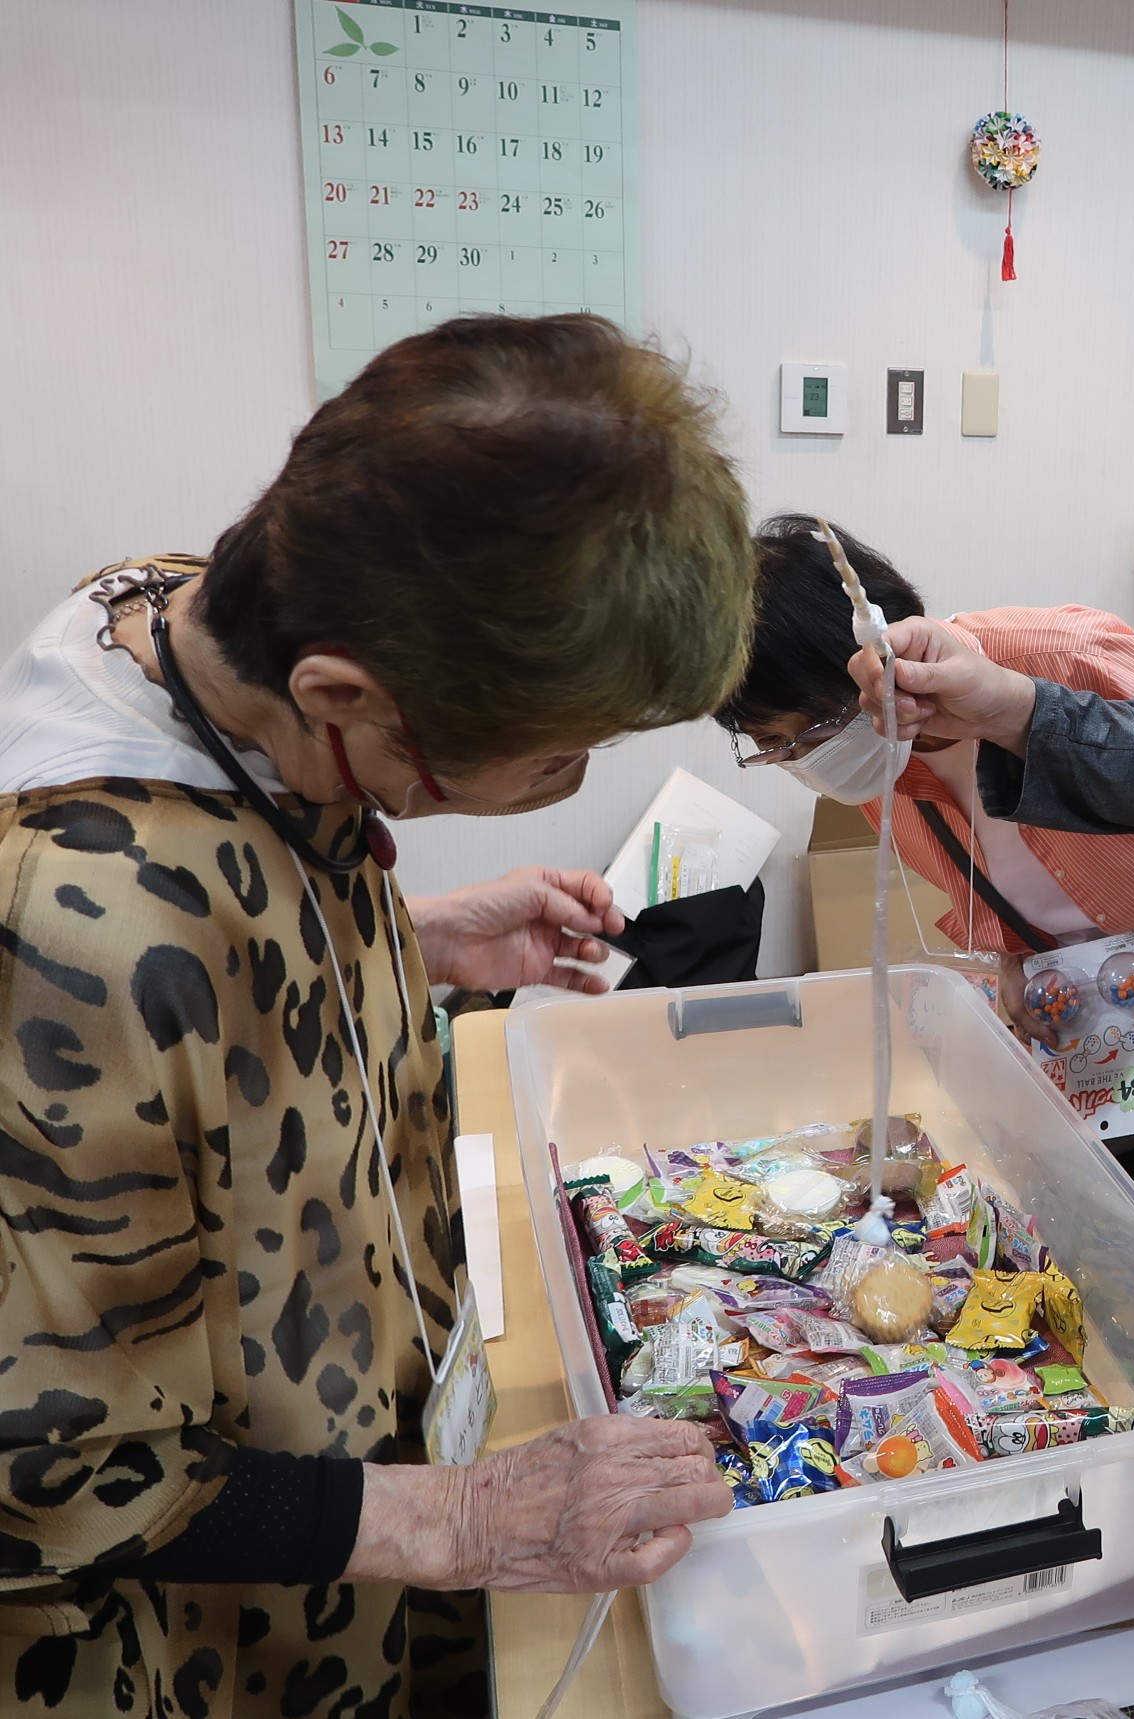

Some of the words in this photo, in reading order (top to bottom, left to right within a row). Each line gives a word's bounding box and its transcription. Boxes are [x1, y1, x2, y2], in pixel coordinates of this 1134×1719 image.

[416, 1, 424, 9] 火
[460, 6, 468, 14] 水
[504, 10, 512, 18] 木
[549, 15, 556, 23] 金
[590, 19, 598, 27] 土
[414, 14, 422, 34] 1
[457, 18, 470, 39] 2
[500, 23, 511, 43] 3
[543, 28, 554, 47] 4
[586, 32, 596, 51] 5
[323, 65, 336, 85] 6
[370, 69, 380, 89] 7
[414, 72, 426, 93] 8
[458, 76, 470, 96] 9
[498, 81, 518, 101] 10
[541, 85, 559, 105] 11
[583, 88, 602, 108] 12
[323, 124, 344, 145] 13
[367, 127, 389, 148] 14
[412, 131, 434, 151] 15
[456, 134, 477, 155] 16
[500, 138, 520, 157] 17
[542, 141, 562, 161] 18
[584, 144, 604, 164] 19
[324, 182, 347, 203] 20
[369, 185, 392, 205] 21
[414, 188, 435, 208] 22
[458, 191, 479, 211] 23
[500, 193, 521, 214] 24
[542, 196, 564, 217] 25
[584, 199, 605, 219] 26
[328, 239, 350, 260] 27
[372, 242, 395, 262] 28
[416, 244, 438, 264] 29
[459, 247, 481, 267] 30
[510, 250, 515, 261] 1
[551, 252, 558, 263] 2
[592, 254, 599, 265] 3
[338, 297, 344, 308] 4
[382, 299, 389, 310] 5
[425, 301, 433, 312] 6
[809, 392, 819, 401] 23
[1076, 1075, 1096, 1089] BALL
[1098, 1073, 1113, 1085] THE
[859, 1409, 874, 1441] ラムネ
